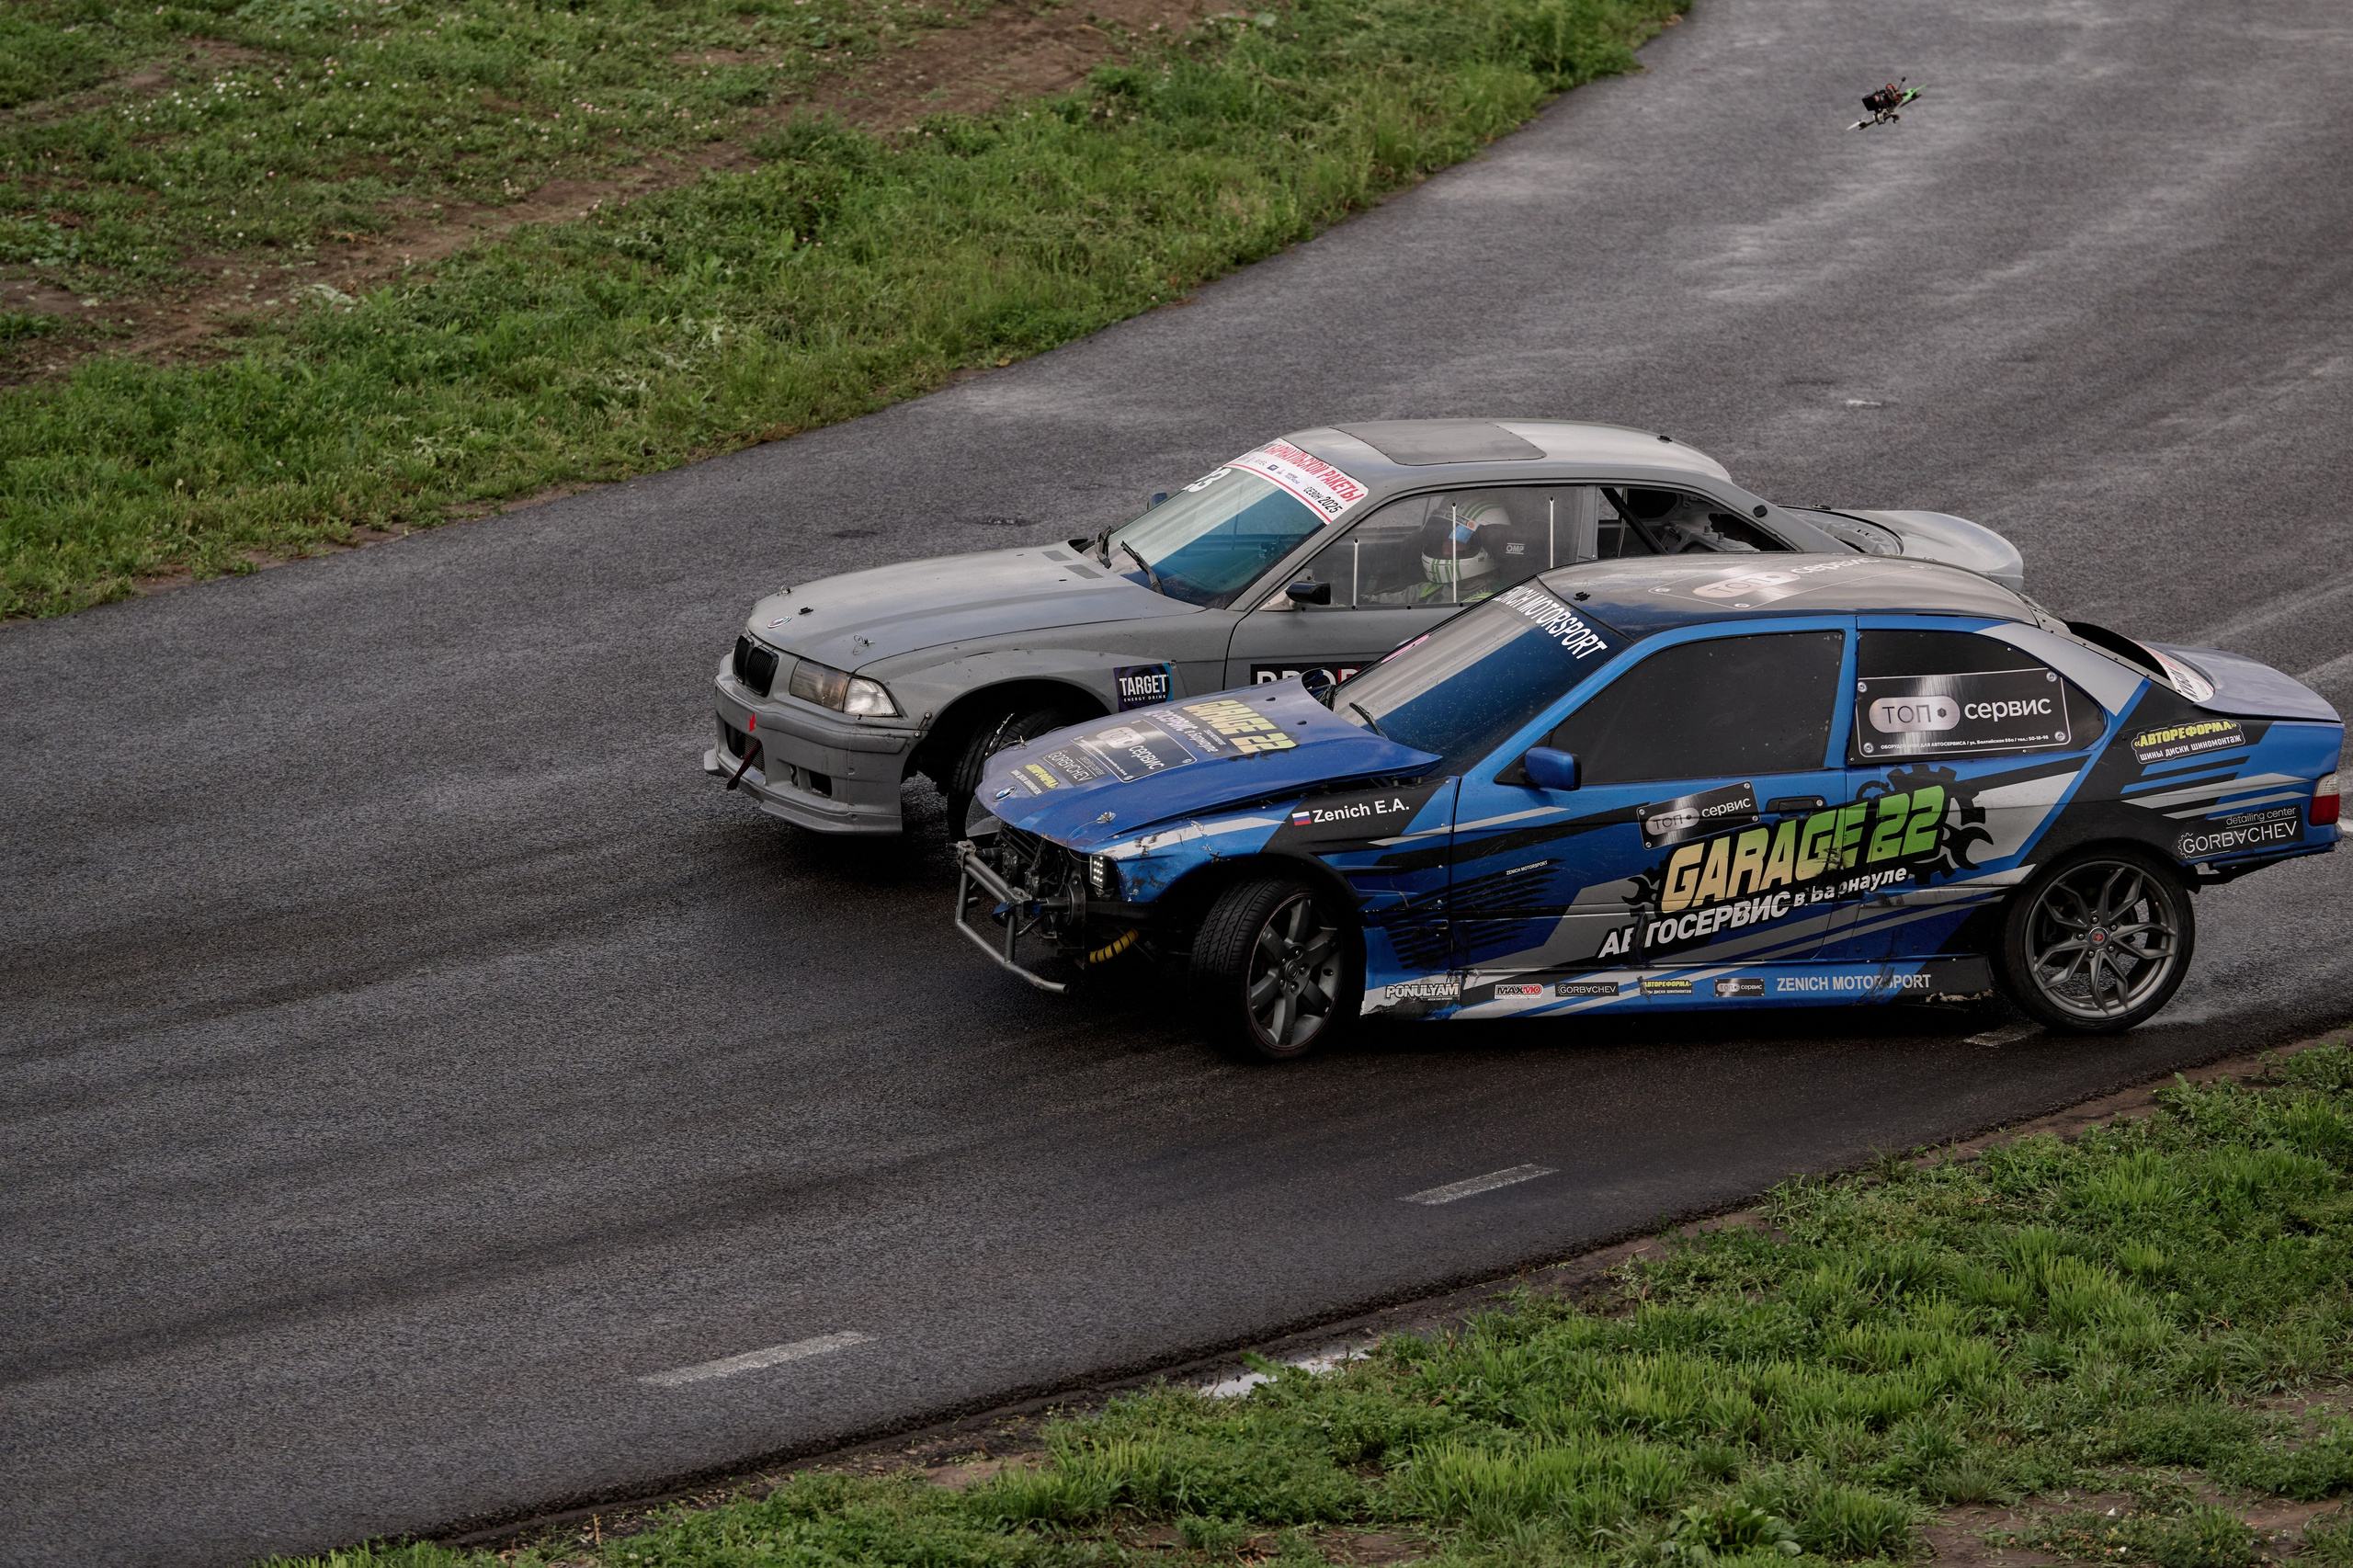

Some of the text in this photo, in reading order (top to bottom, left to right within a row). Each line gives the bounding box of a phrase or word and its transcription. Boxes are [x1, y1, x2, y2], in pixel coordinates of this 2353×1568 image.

[1316, 470, 1365, 503] РАКЕТЫ
[1317, 495, 1343, 514] 2025
[1506, 544, 1525, 553] OMP
[1517, 595, 1608, 660] MOTORSPORT
[1119, 674, 1168, 697] TARGET
[1181, 699, 1278, 735] GARAGE
[1881, 698, 2052, 724] ТОП сервис
[1229, 733, 1297, 754] 22
[2134, 721, 2237, 747] «АВТОРЕФОРМА»
[1129, 744, 1165, 770] сервис
[2139, 734, 2243, 761] шины диски шиномонтаж
[1313, 798, 1410, 824] Zenich E.A.
[1653, 798, 1752, 830] ТОП сервис
[2225, 808, 2297, 826] detailing center
[1661, 785, 1945, 915] GARAGE 22
[1793, 891, 1806, 907] в
[1385, 983, 1461, 998] PONULYAM
[1740, 983, 1763, 992] сервис
[1776, 976, 1829, 992] ZENICH
